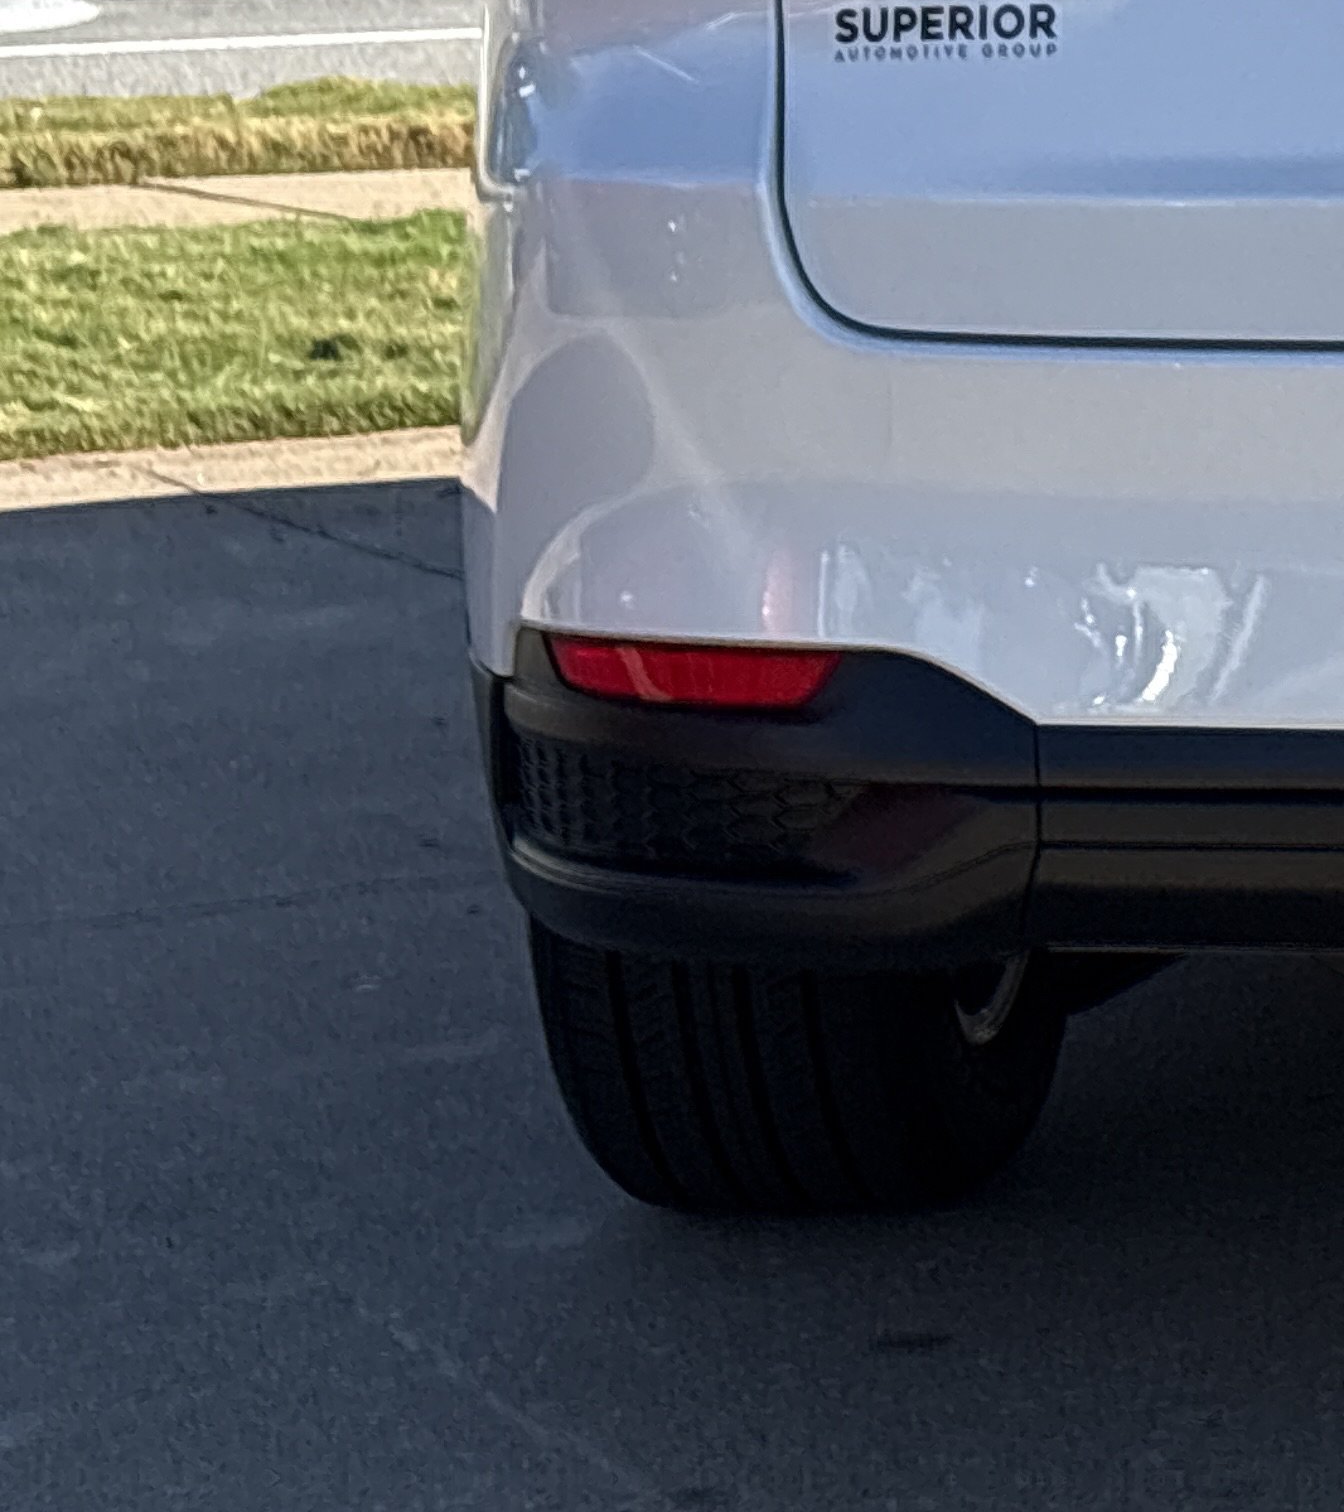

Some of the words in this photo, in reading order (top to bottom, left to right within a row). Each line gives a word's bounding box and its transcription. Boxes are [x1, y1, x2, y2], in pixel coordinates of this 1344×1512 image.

[835, 3, 1057, 42] SUPERIOR
[834, 43, 968, 63] AUTOMOTIVE
[981, 42, 1058, 59] GROUP
